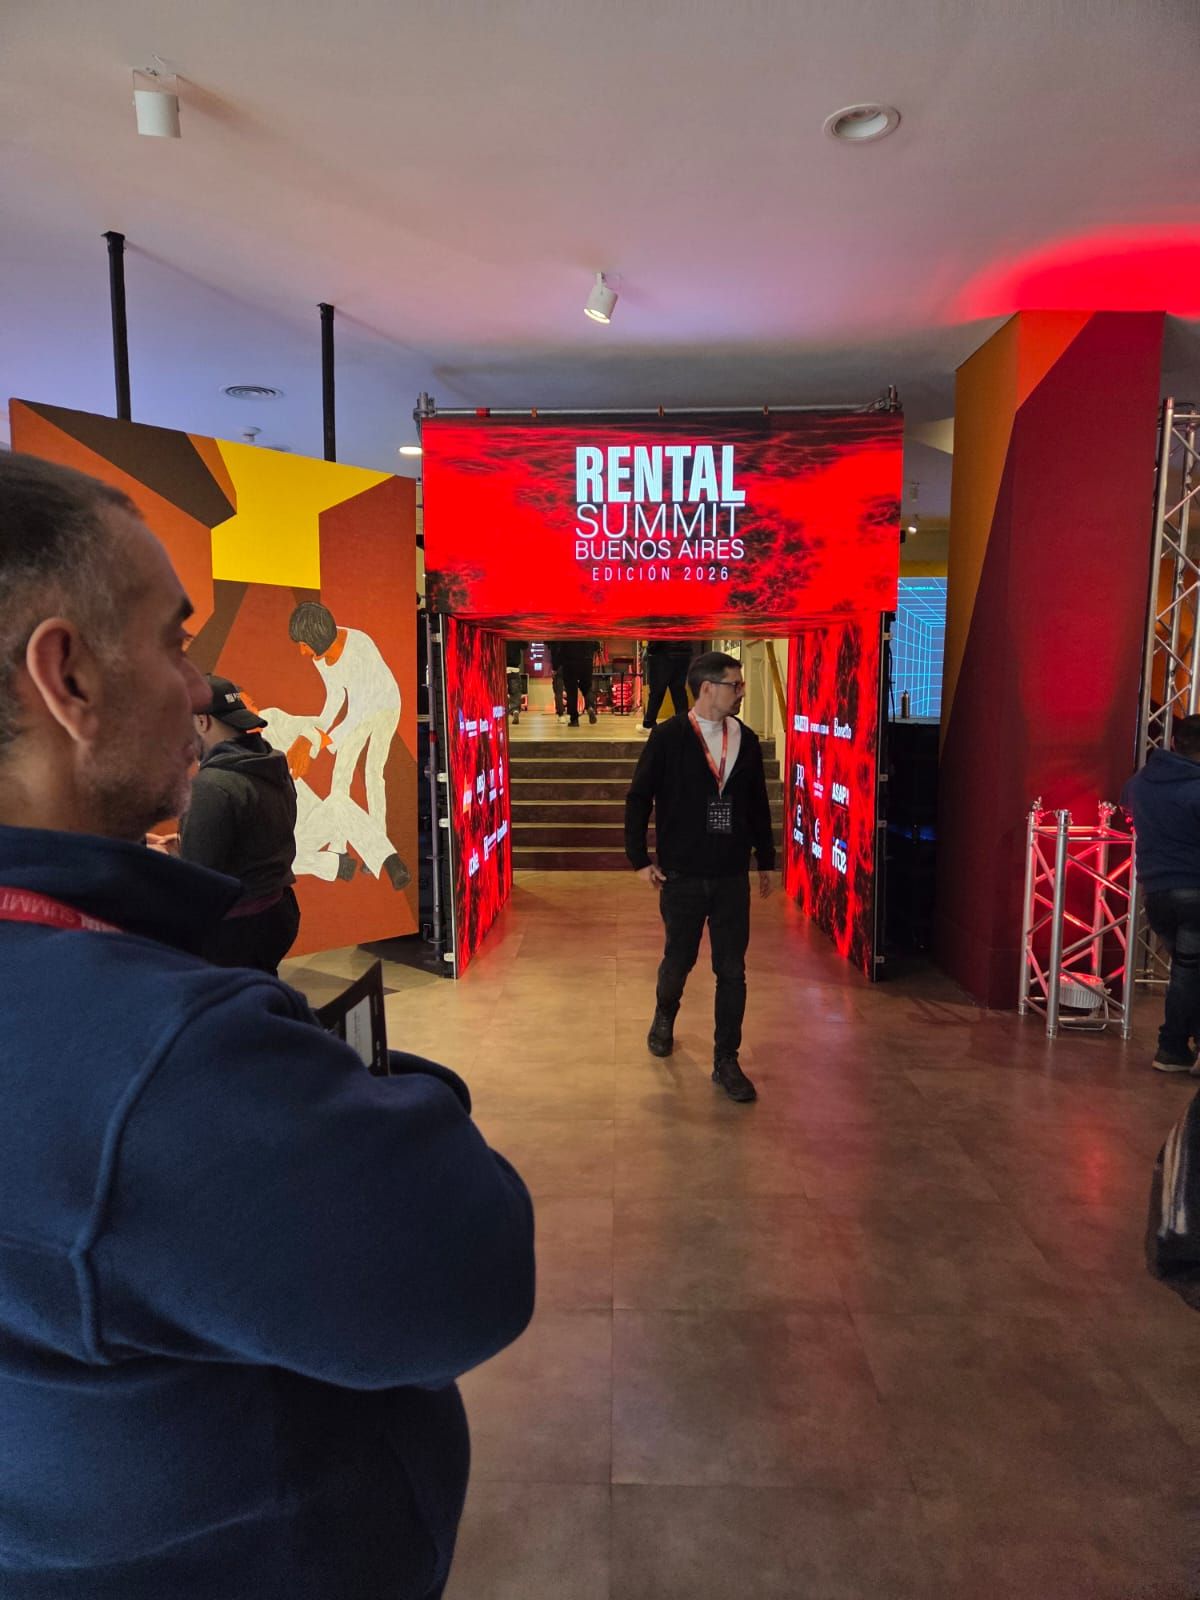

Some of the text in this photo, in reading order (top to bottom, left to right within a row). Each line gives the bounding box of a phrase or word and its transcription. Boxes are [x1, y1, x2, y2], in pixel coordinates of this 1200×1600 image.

[576, 445, 746, 503] RENTAL
[575, 503, 746, 539] SUMMIT
[575, 539, 745, 560] BUENOS AIRES
[592, 566, 729, 581] EDICIÓN 2026
[0, 893, 76, 923] SUMMI
